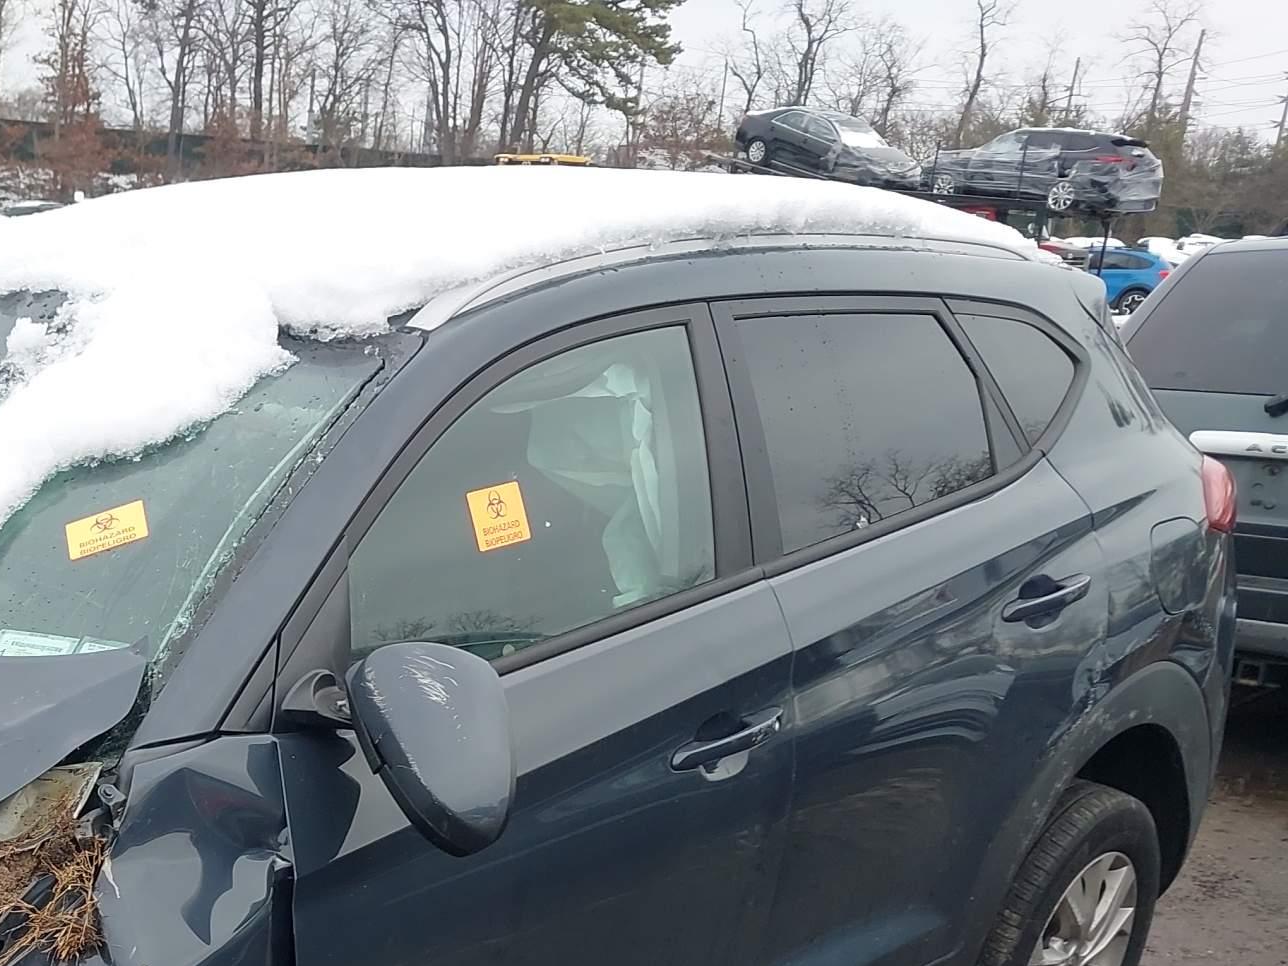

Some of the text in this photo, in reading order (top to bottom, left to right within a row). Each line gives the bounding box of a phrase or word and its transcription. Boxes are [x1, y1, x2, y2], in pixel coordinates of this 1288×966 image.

[79, 526, 136, 549] BIOHAZARD
[482, 519, 521, 537] BIOHAZARD
[79, 532, 137, 555] BIOPELIGRO
[485, 531, 524, 547] BIOPELIGRO
